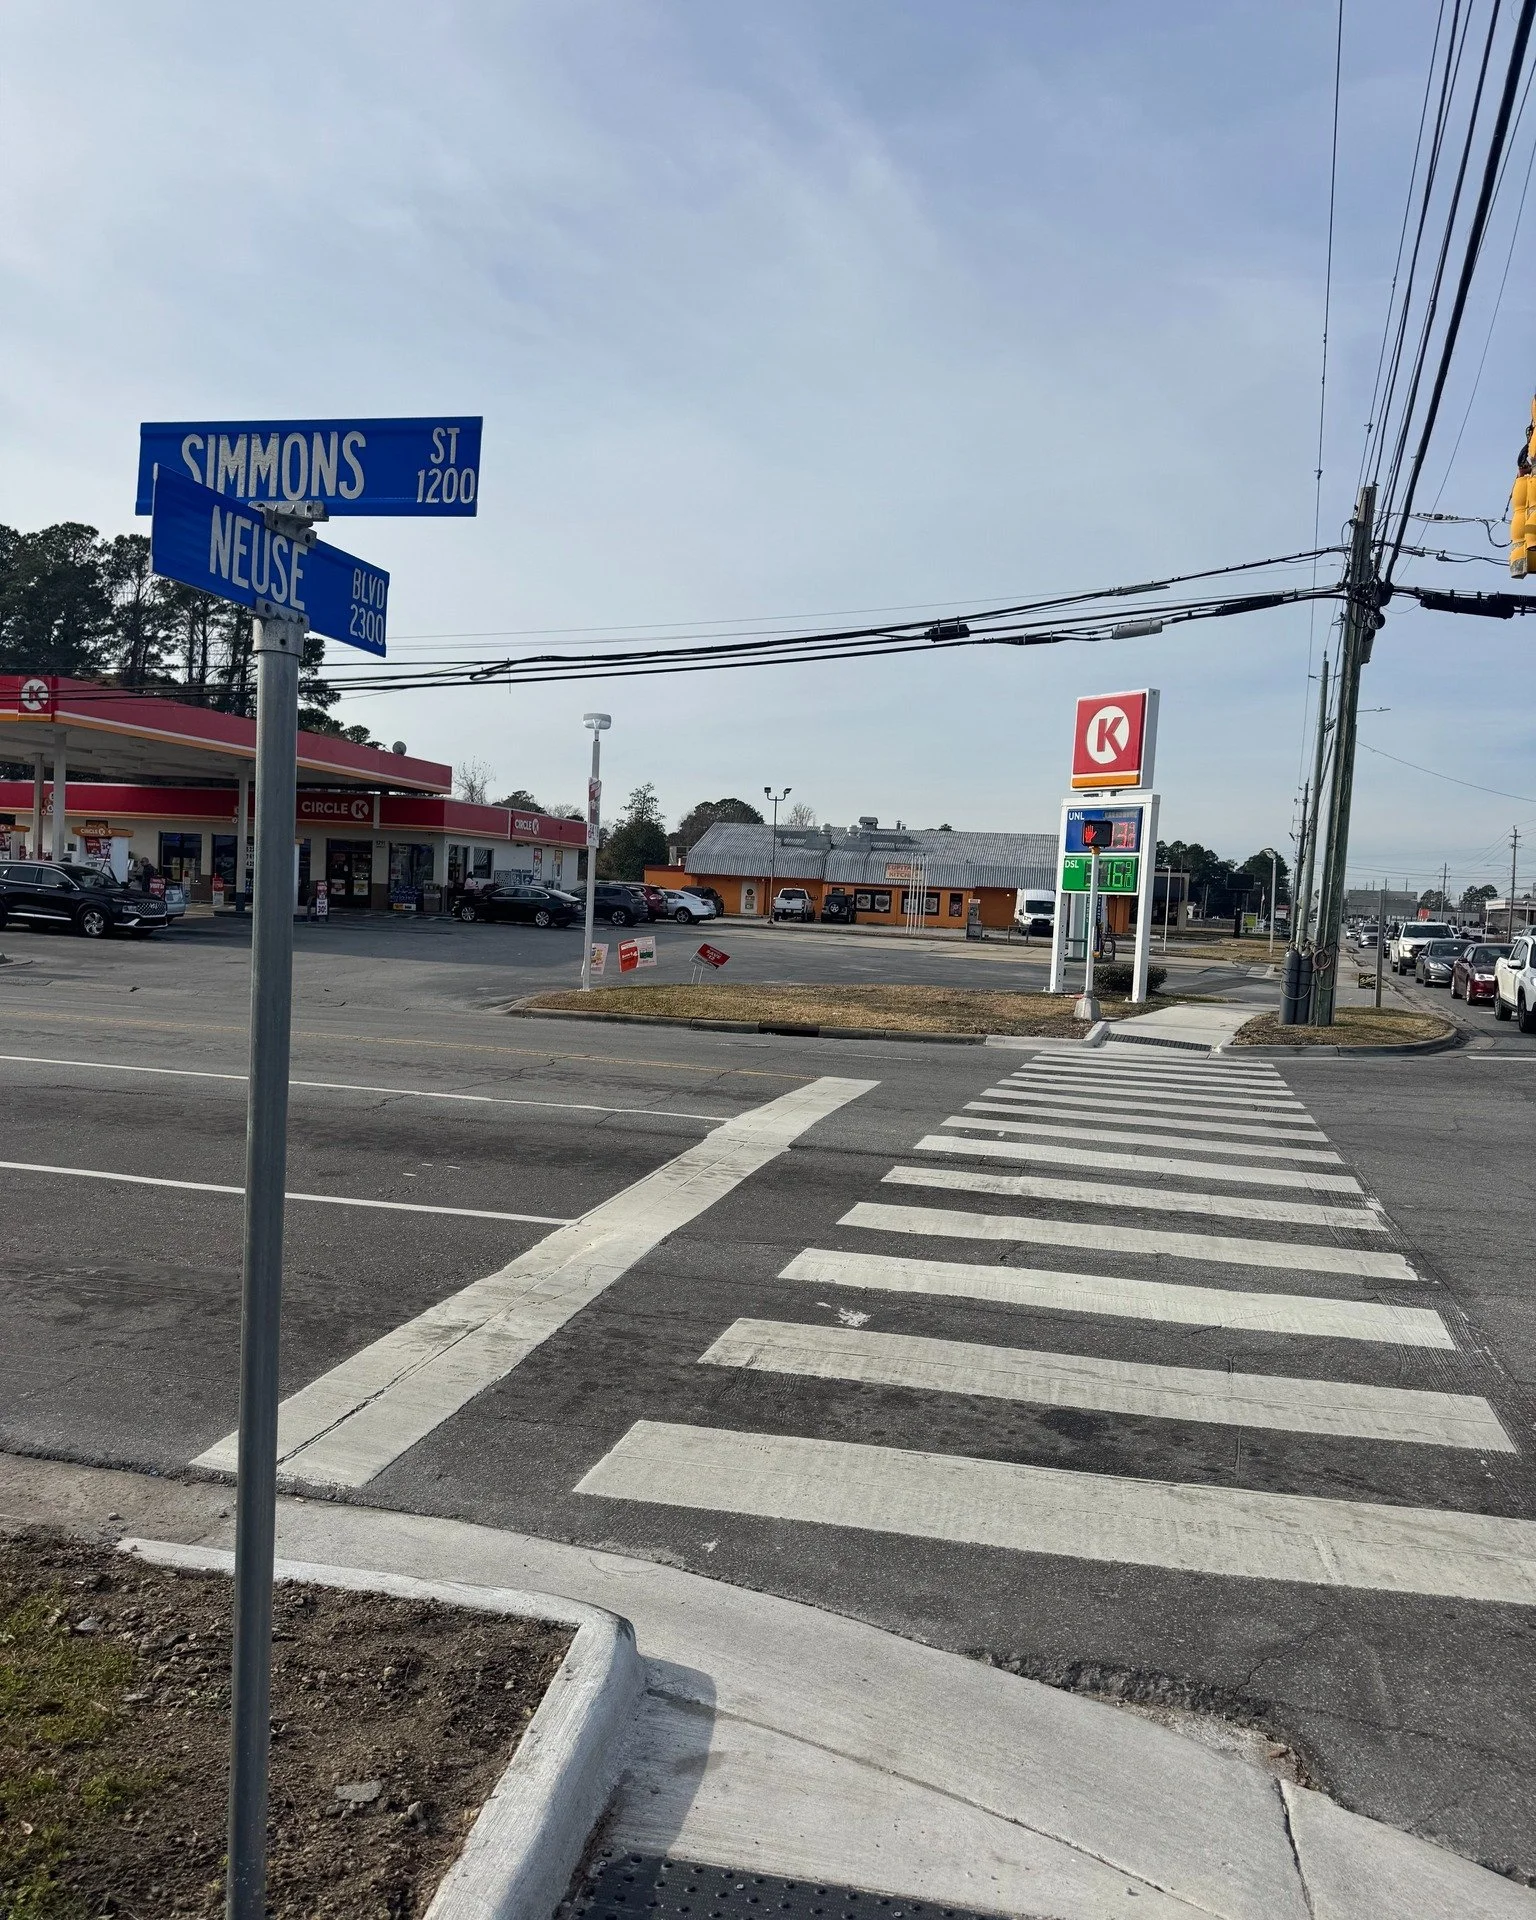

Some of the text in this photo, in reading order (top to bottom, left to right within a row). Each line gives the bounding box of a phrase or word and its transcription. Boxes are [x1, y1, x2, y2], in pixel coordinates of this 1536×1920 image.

[181, 427, 461, 501] SIMMONS ST
[416, 468, 476, 504] 1200
[209, 504, 308, 611] NEUSE
[352, 568, 386, 610] BLVD
[350, 604, 384, 646] 2300
[1091, 710, 1127, 761] K
[301, 800, 369, 818] CIRCLE K
[515, 818, 540, 835] CIRCLE K
[1068, 812, 1085, 820] UNL
[1064, 860, 1079, 868] DSL
